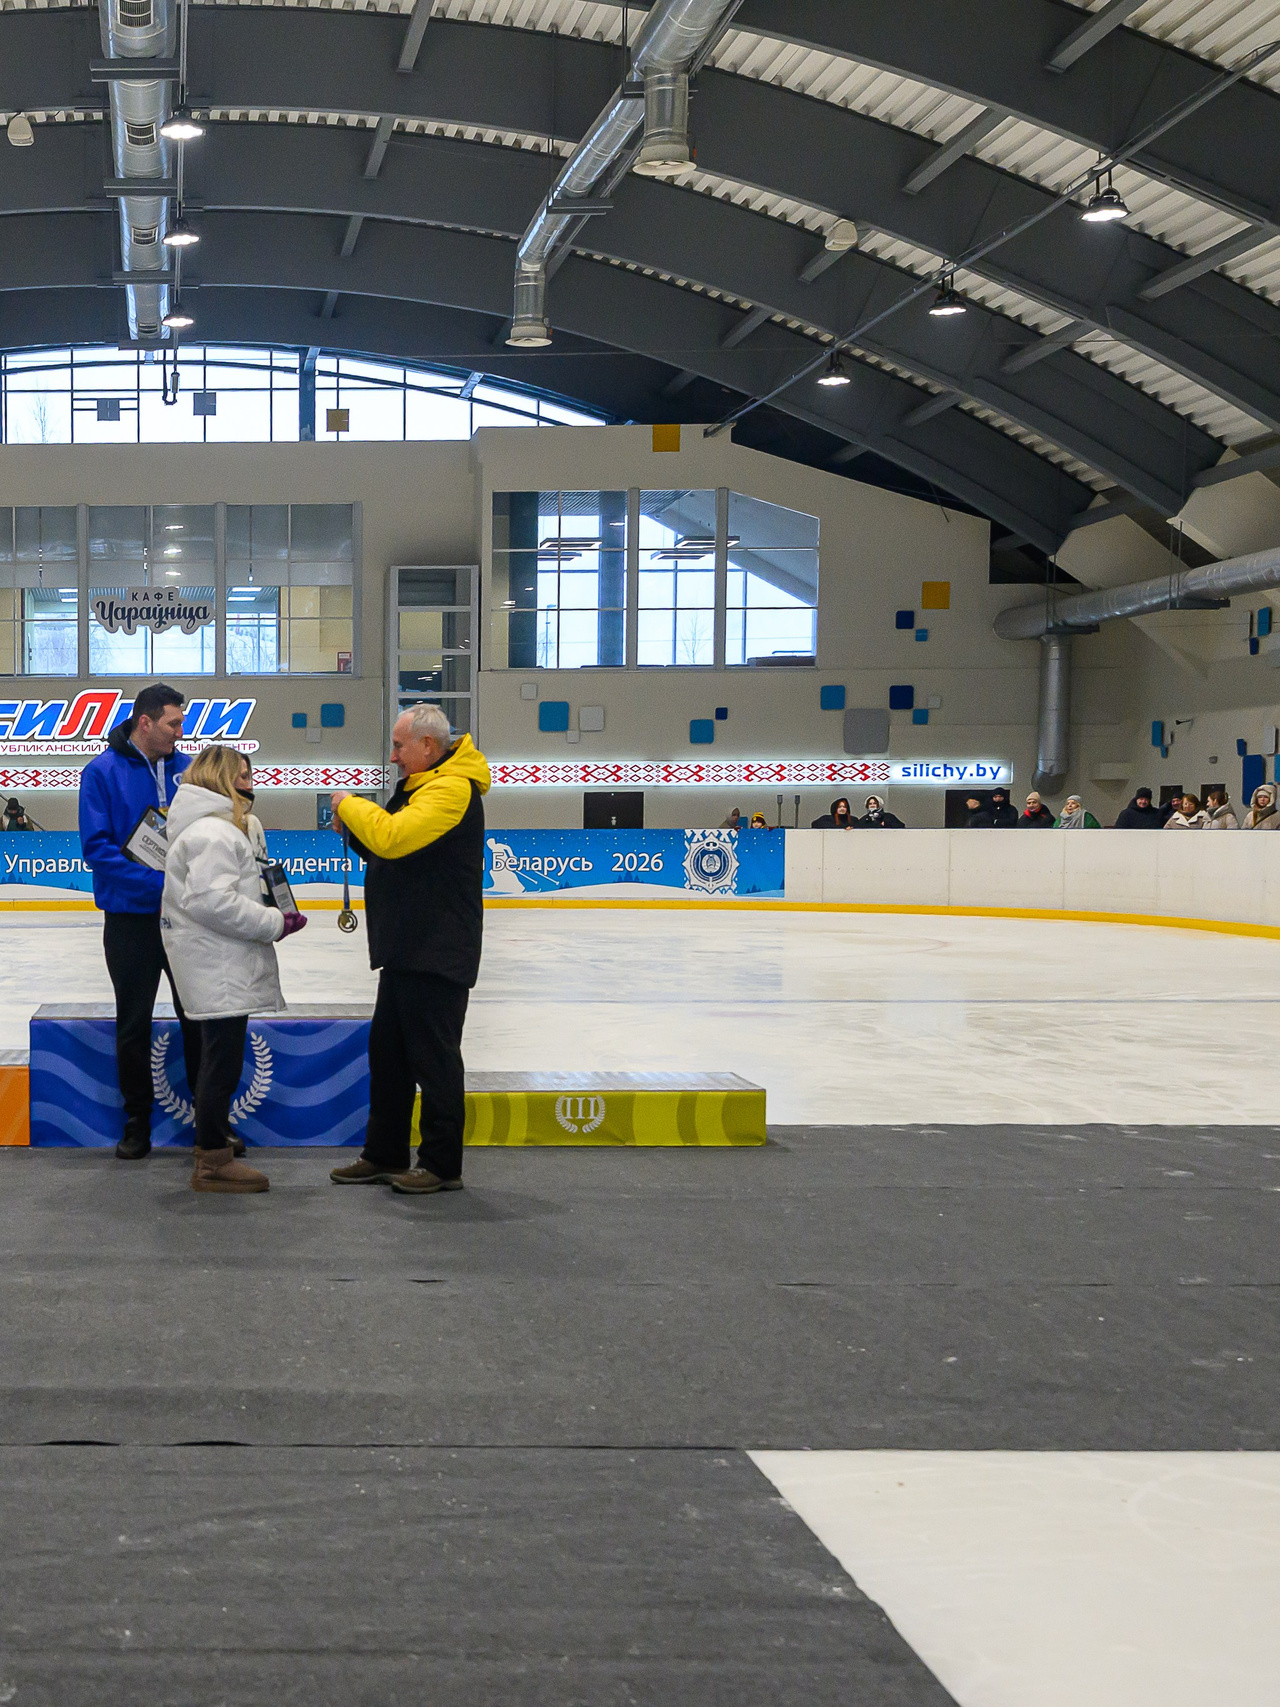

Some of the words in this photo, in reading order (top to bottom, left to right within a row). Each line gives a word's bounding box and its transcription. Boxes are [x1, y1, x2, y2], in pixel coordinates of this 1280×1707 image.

[131, 591, 175, 602] КАФЕ
[901, 763, 1002, 780] silichy.by
[492, 851, 594, 876] Беларусь
[611, 852, 664, 872] 2026
[565, 1097, 597, 1119] III
